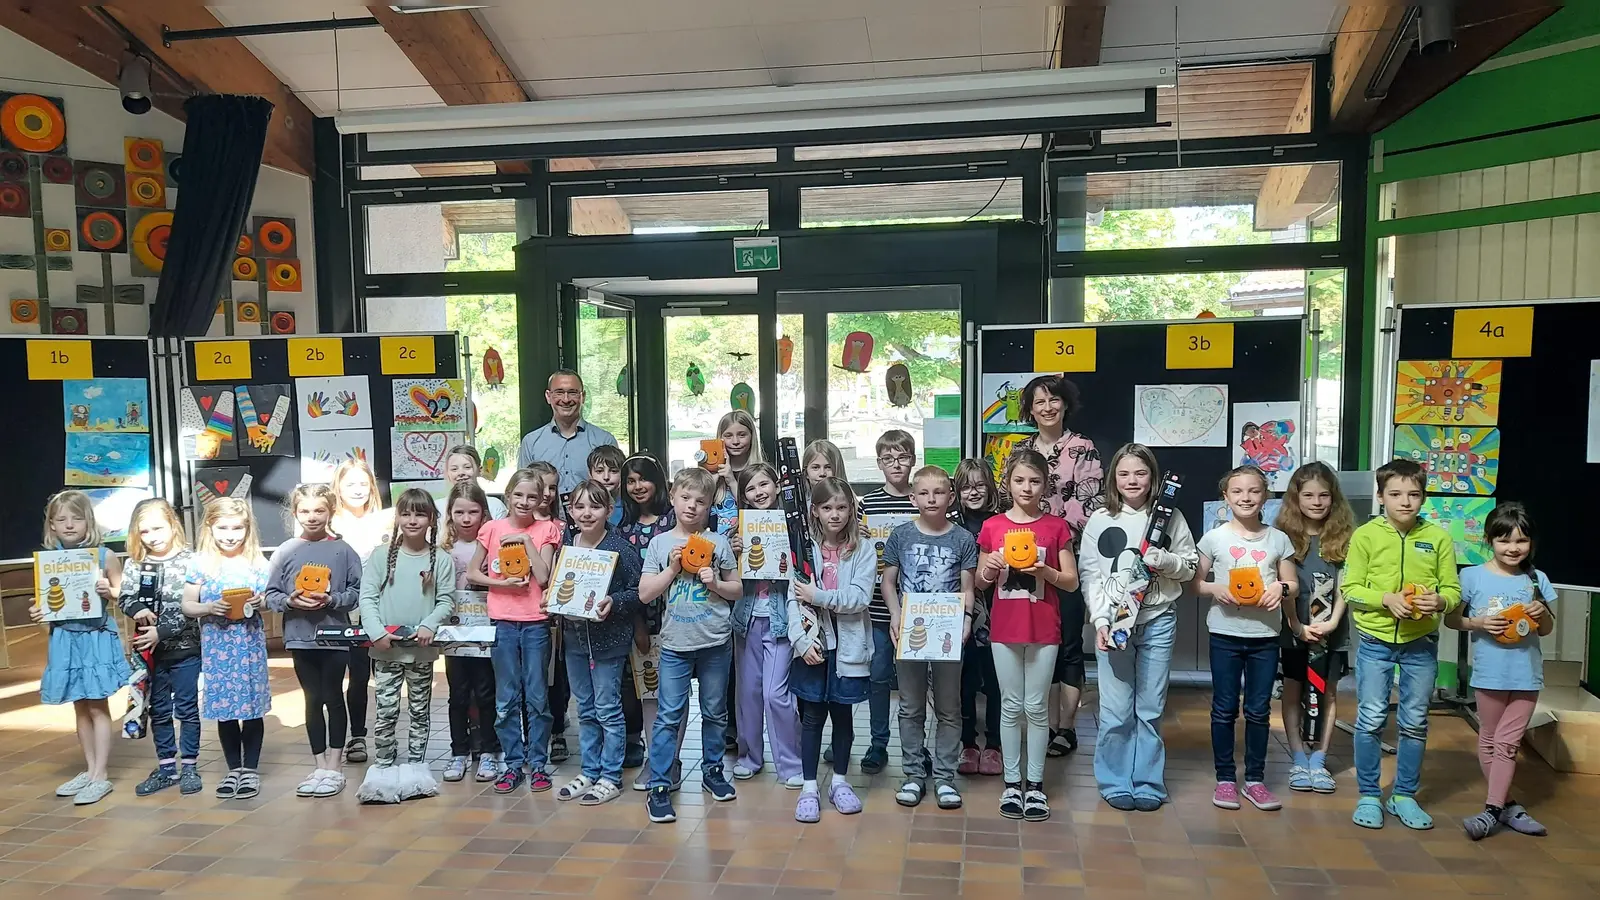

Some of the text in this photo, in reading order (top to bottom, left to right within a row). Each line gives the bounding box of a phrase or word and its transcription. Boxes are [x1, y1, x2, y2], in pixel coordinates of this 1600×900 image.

[1479, 321, 1505, 338] 4a
[1055, 341, 1075, 356] 3a
[1188, 335, 1211, 351] 3b
[50, 350, 69, 364] 1b
[214, 352, 232, 365] 2a
[305, 348, 325, 361] 2b
[399, 346, 416, 360] 2c
[870, 527, 889, 538] BIE
[904, 543, 957, 559] STAR
[43, 562, 91, 575] BIENEN
[565, 558, 608, 573] BIENEN
[910, 604, 957, 615] BIENEN
